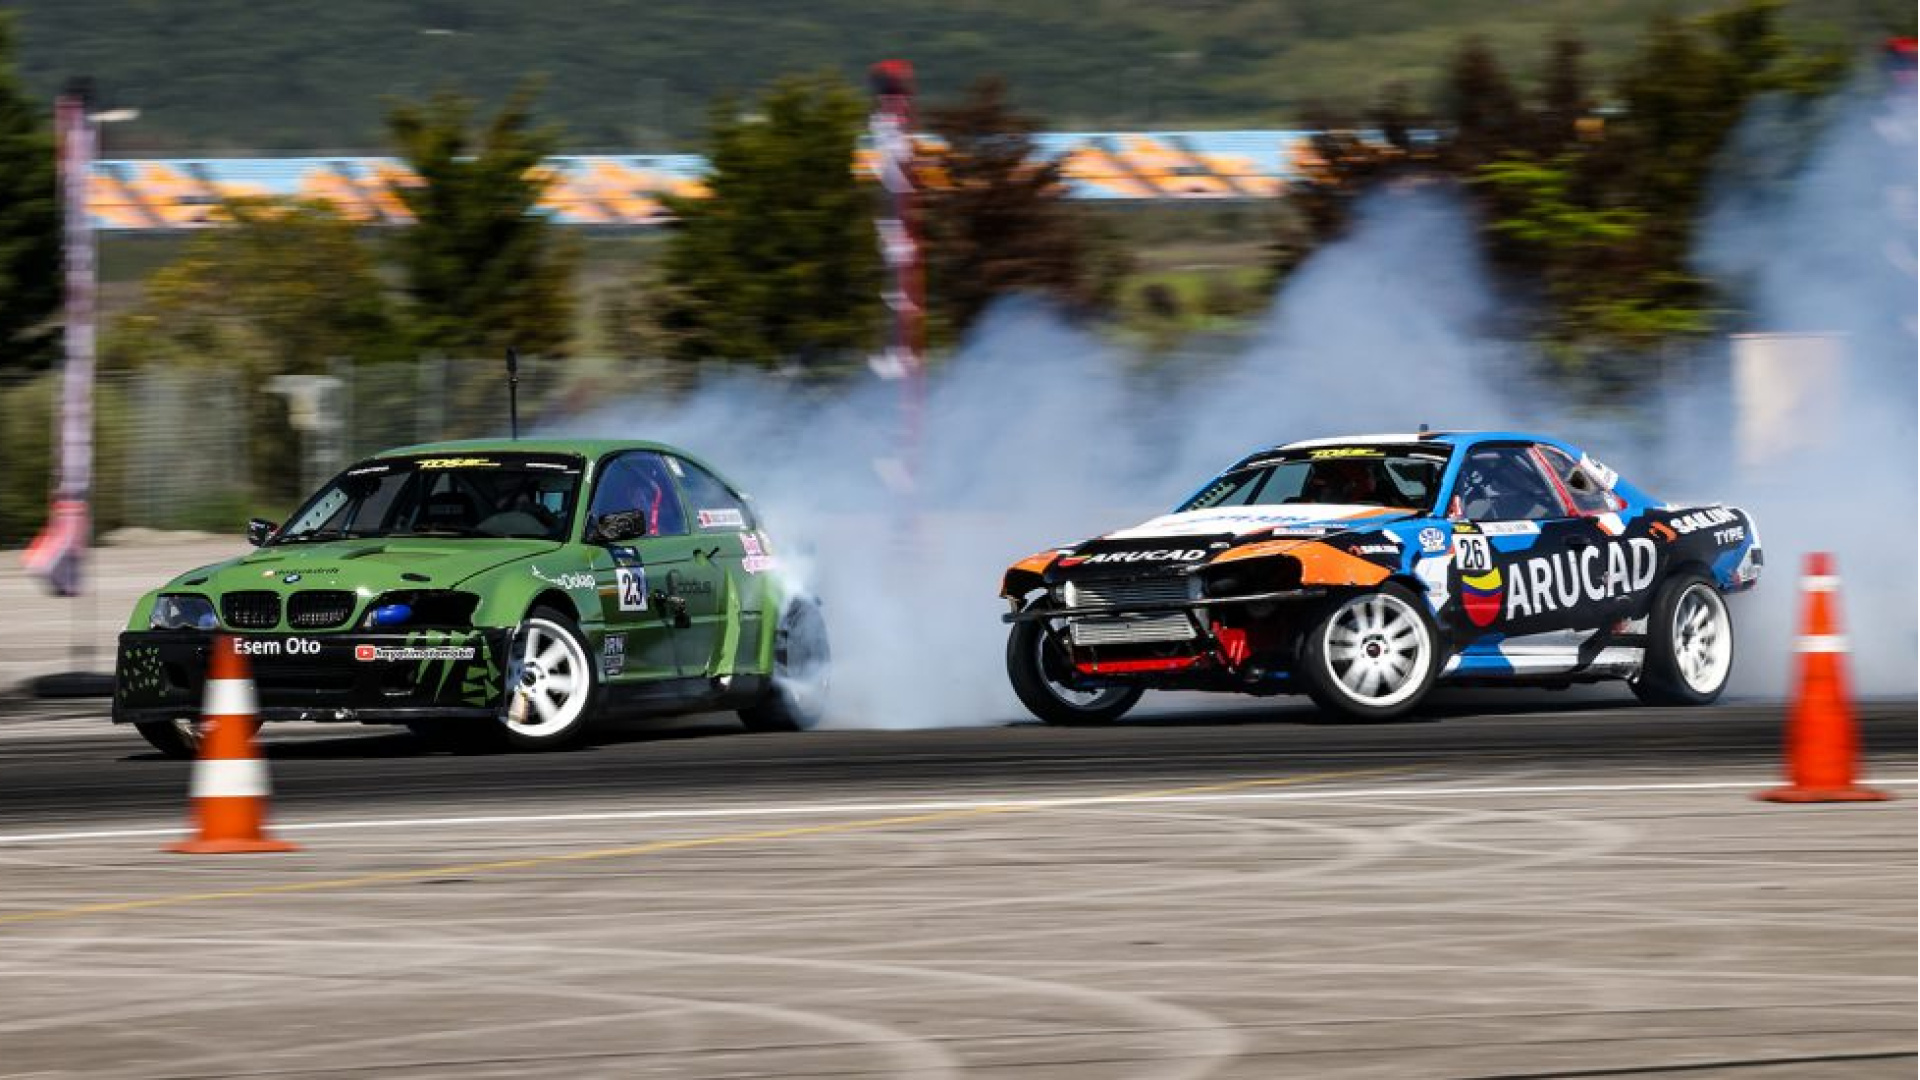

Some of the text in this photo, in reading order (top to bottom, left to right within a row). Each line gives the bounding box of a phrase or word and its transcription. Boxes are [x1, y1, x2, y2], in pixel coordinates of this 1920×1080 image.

[1713, 526, 1745, 545] TYPE
[1082, 549, 1207, 565] ARUCAD
[1460, 538, 1486, 568] 26
[622, 572, 643, 606] 23
[1505, 537, 1658, 621] ARUCAD
[233, 637, 321, 655] Esem Oto
